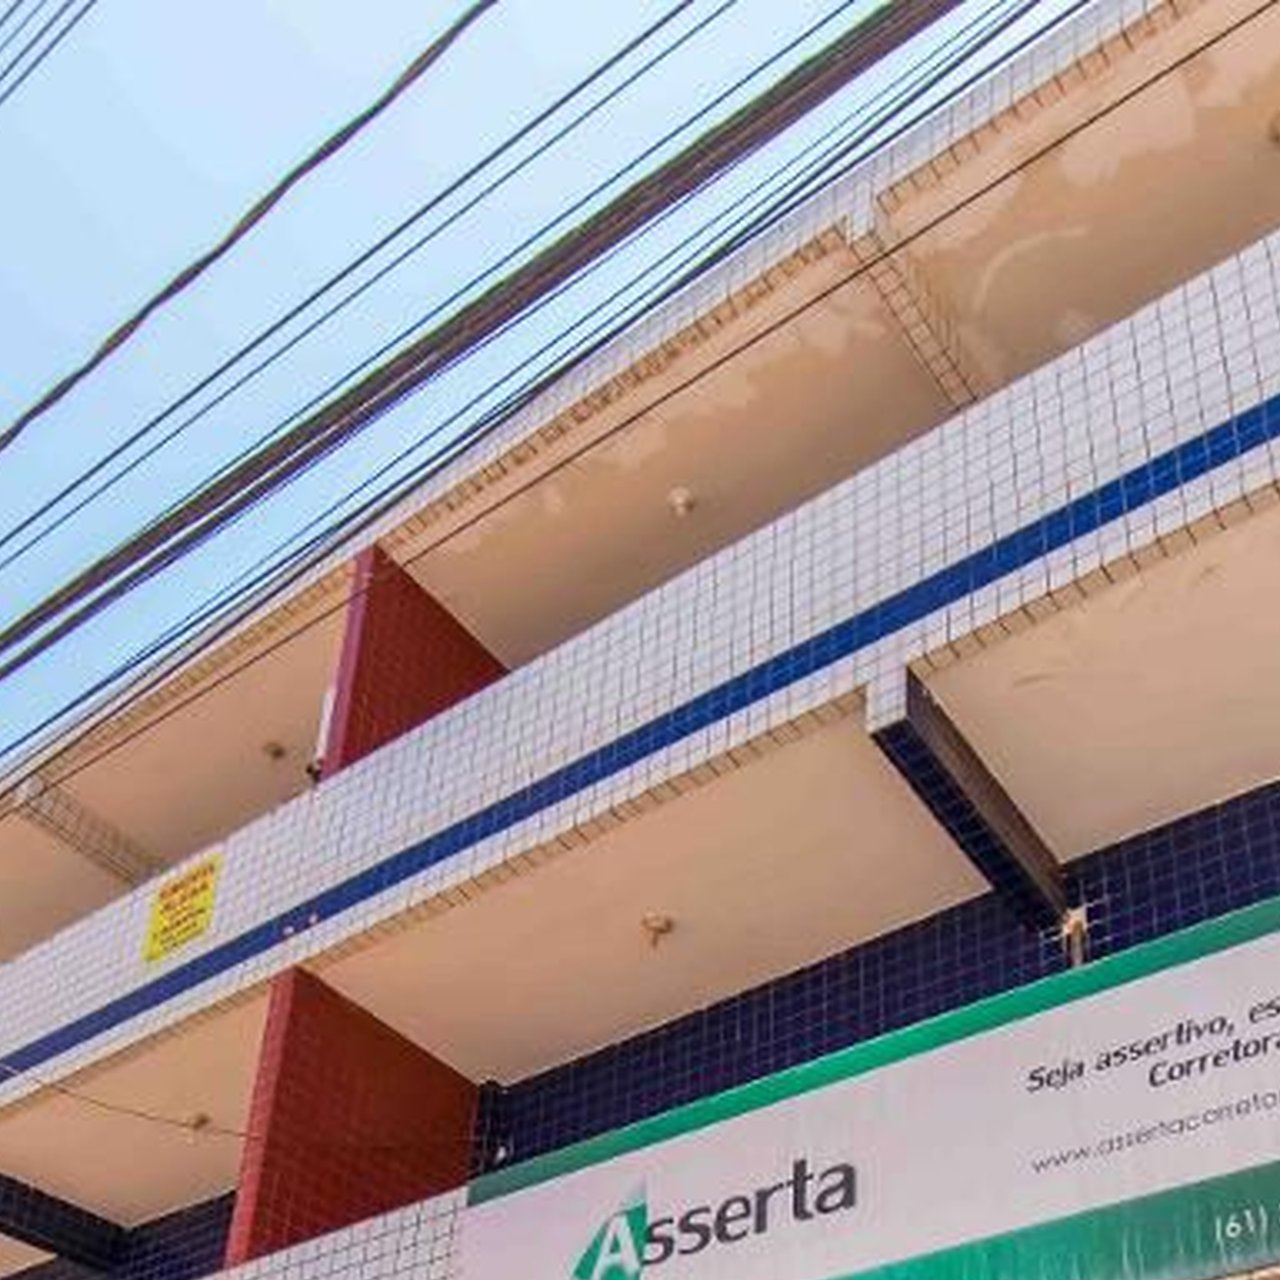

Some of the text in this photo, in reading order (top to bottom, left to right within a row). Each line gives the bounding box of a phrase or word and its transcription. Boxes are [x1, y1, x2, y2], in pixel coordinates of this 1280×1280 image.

[1026, 1060, 1084, 1092] Seja
[1096, 1016, 1234, 1071] assertivo,
[1215, 1205, 1267, 1245] (61)
